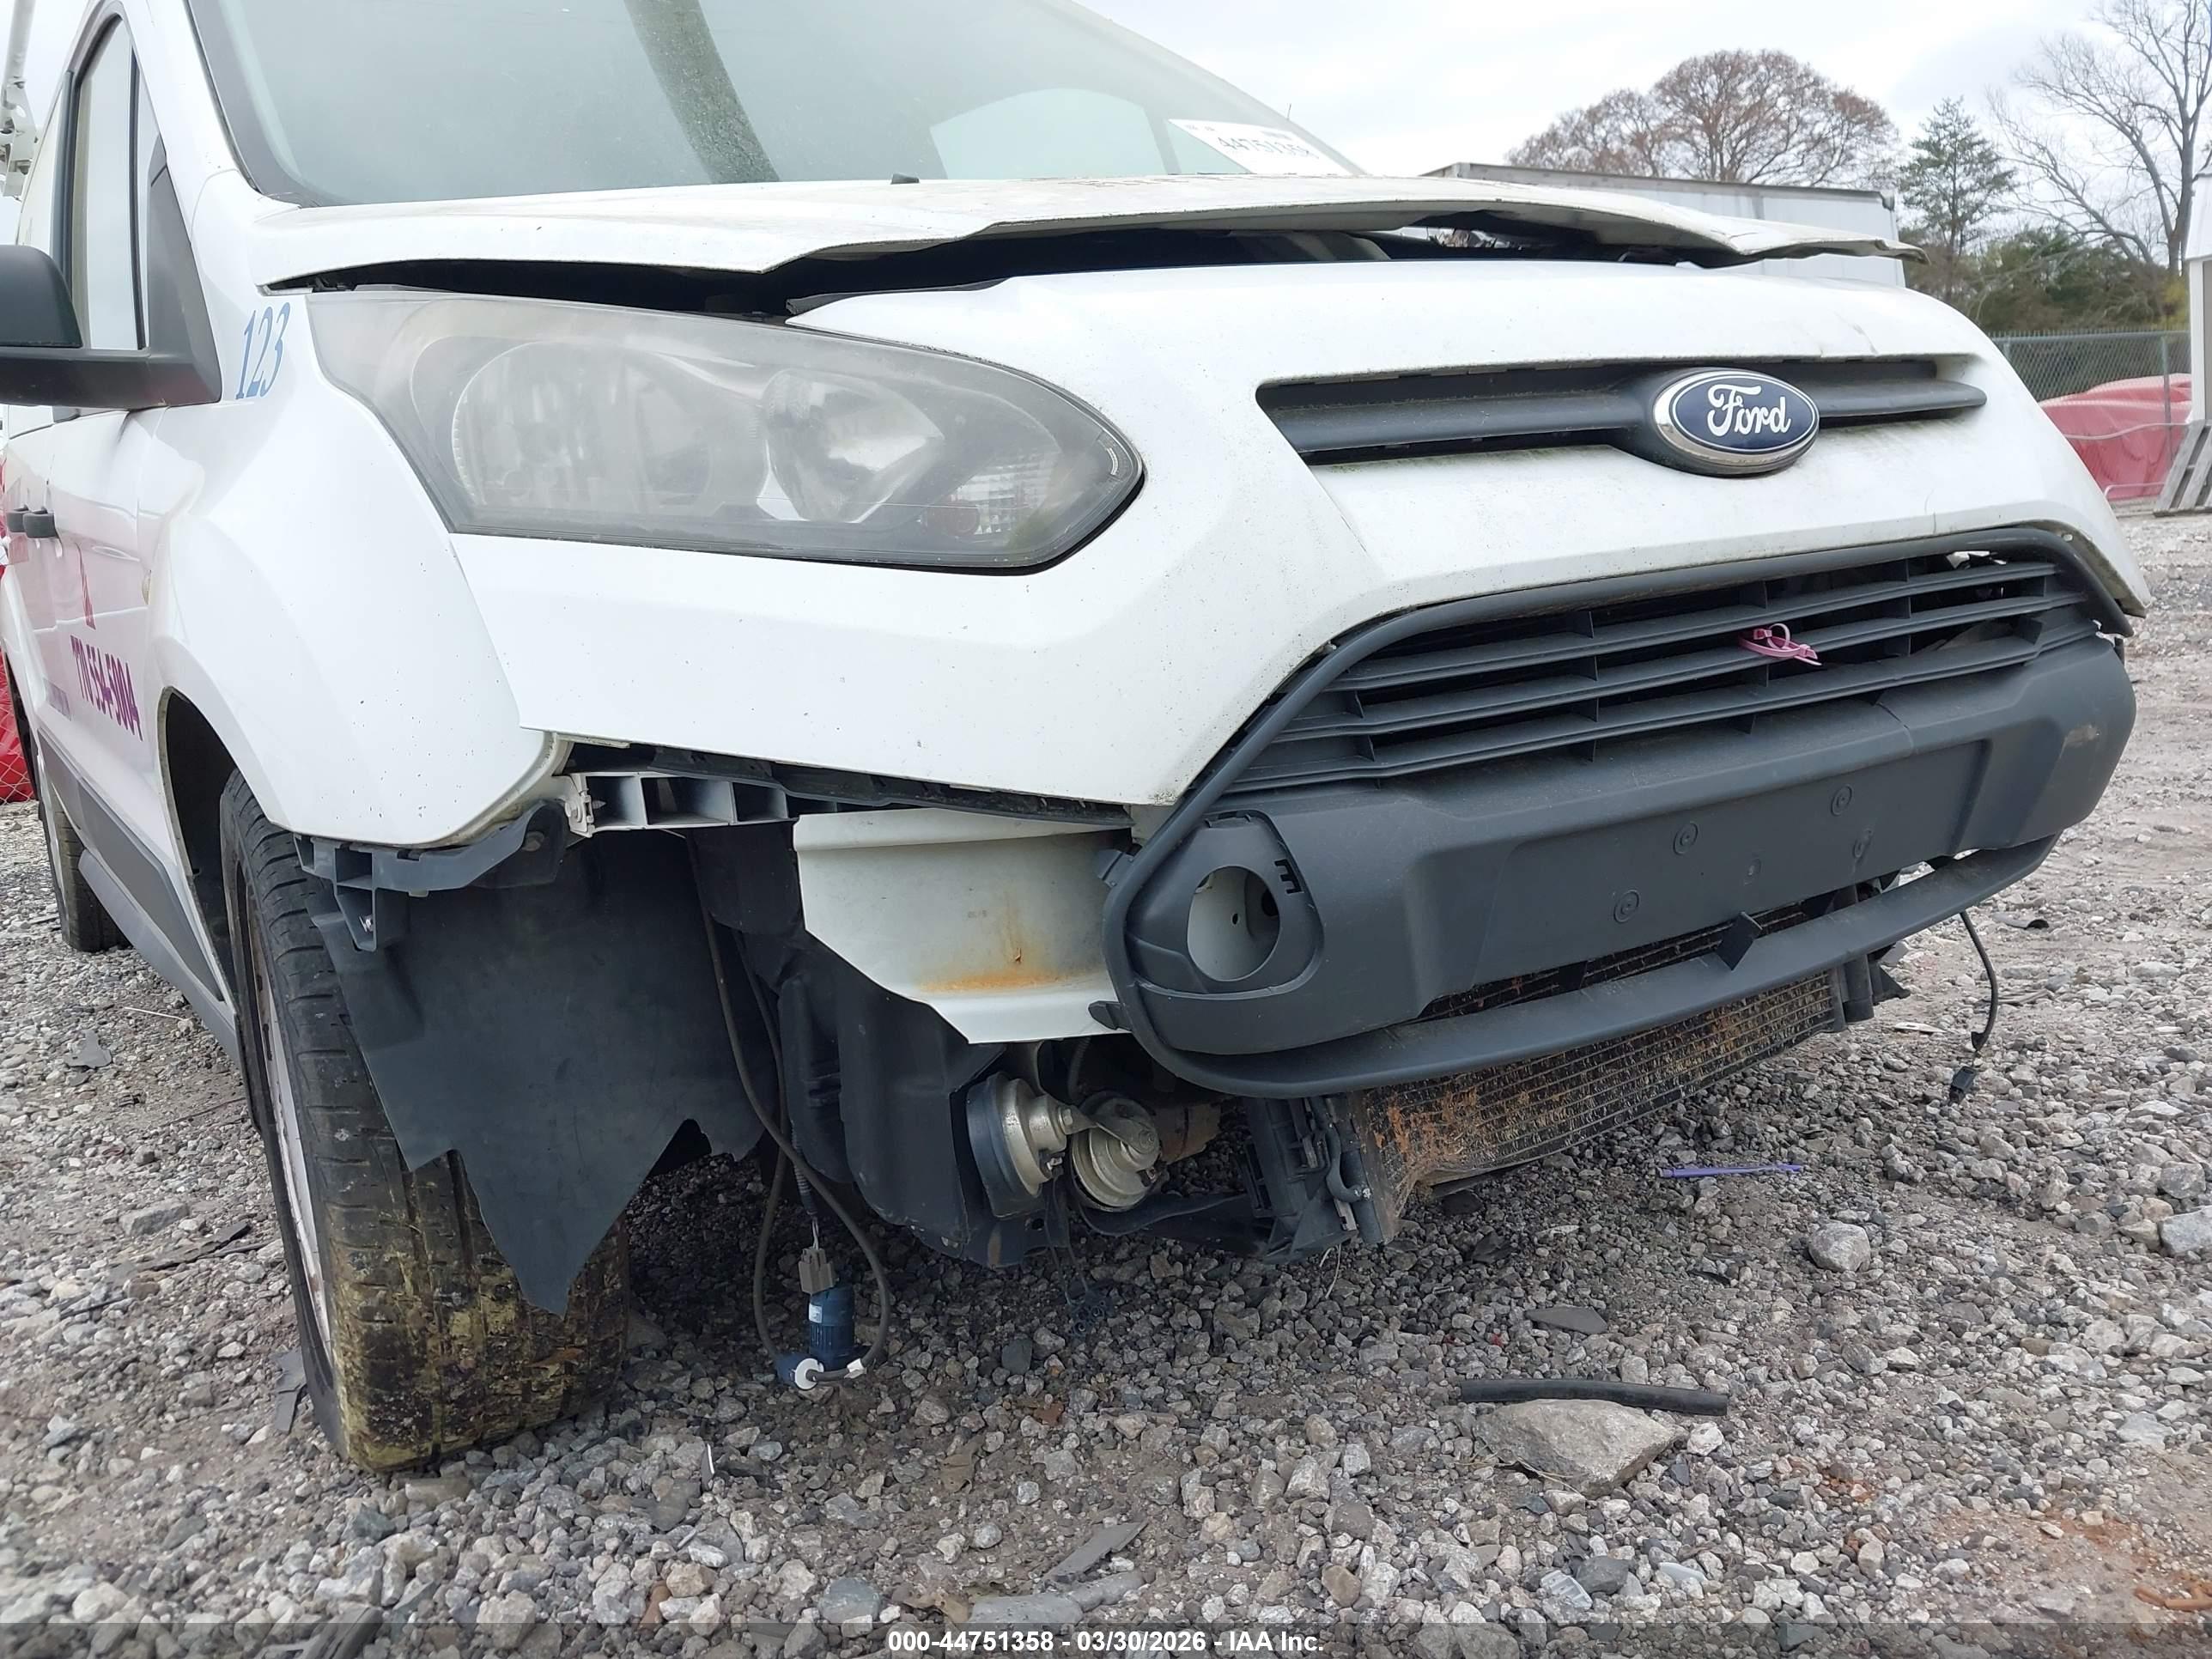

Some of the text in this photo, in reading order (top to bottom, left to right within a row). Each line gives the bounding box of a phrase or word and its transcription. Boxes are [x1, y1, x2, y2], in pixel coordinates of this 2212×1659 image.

[235, 302, 290, 400] 123
[1707, 384, 1791, 436] Ford
[70, 635, 94, 706] 770
